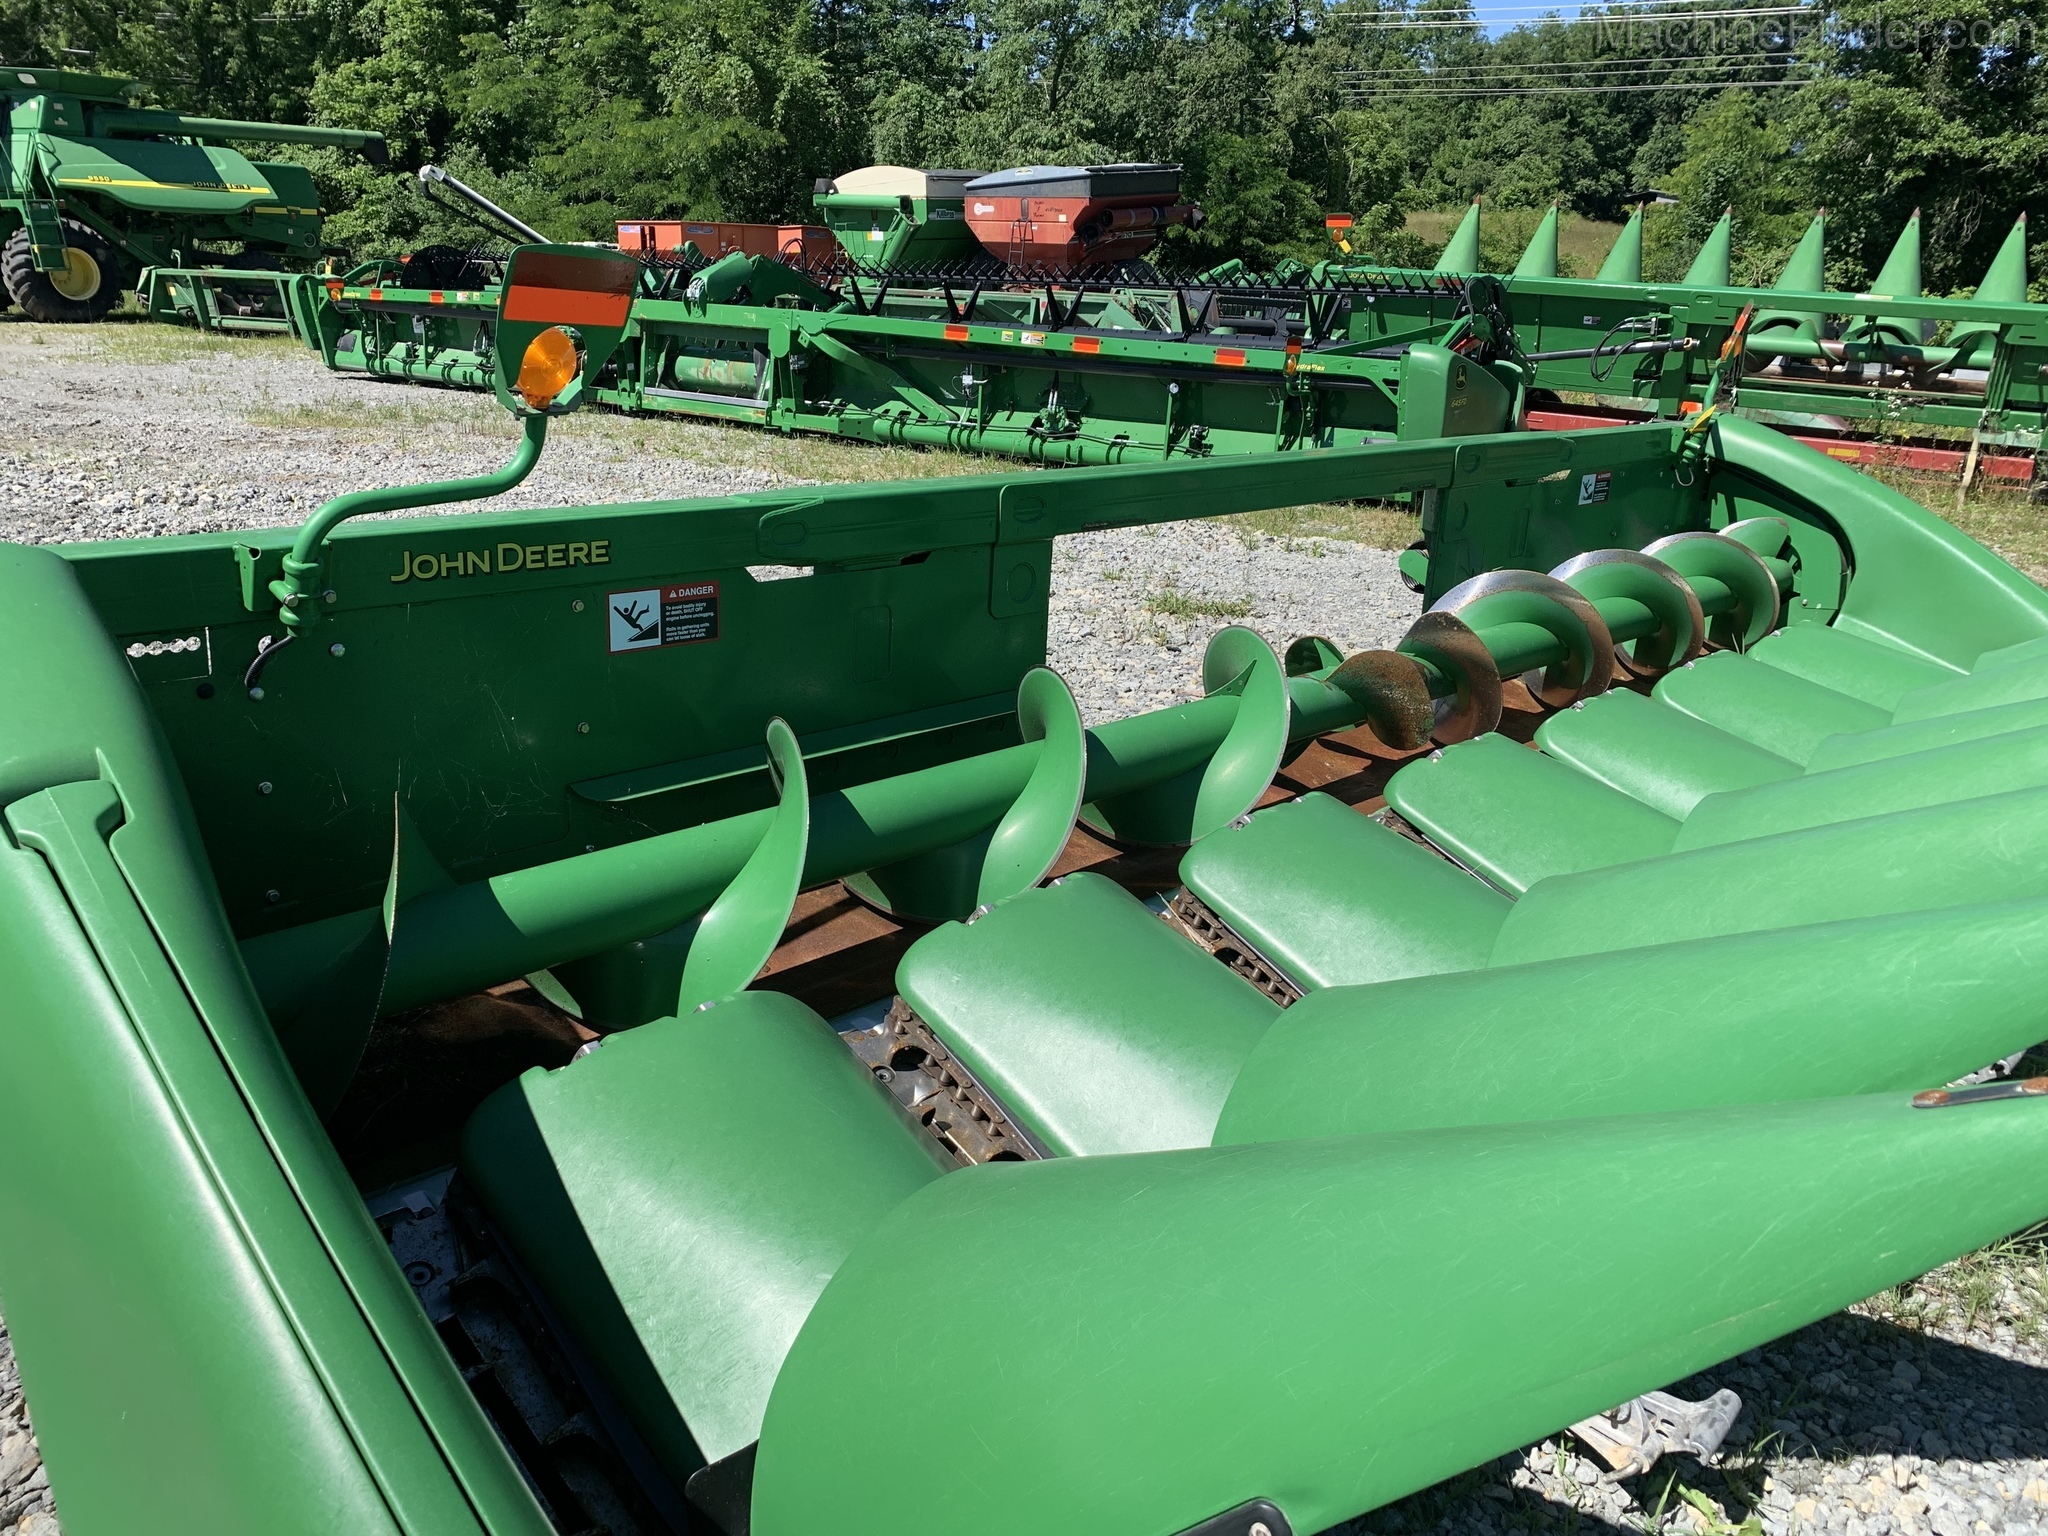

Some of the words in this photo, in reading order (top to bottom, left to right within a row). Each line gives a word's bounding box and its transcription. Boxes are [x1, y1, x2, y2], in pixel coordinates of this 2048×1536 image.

[390, 549, 490, 582] JOHN
[496, 540, 611, 573] DEERE
[678, 586, 714, 597] DANGER
